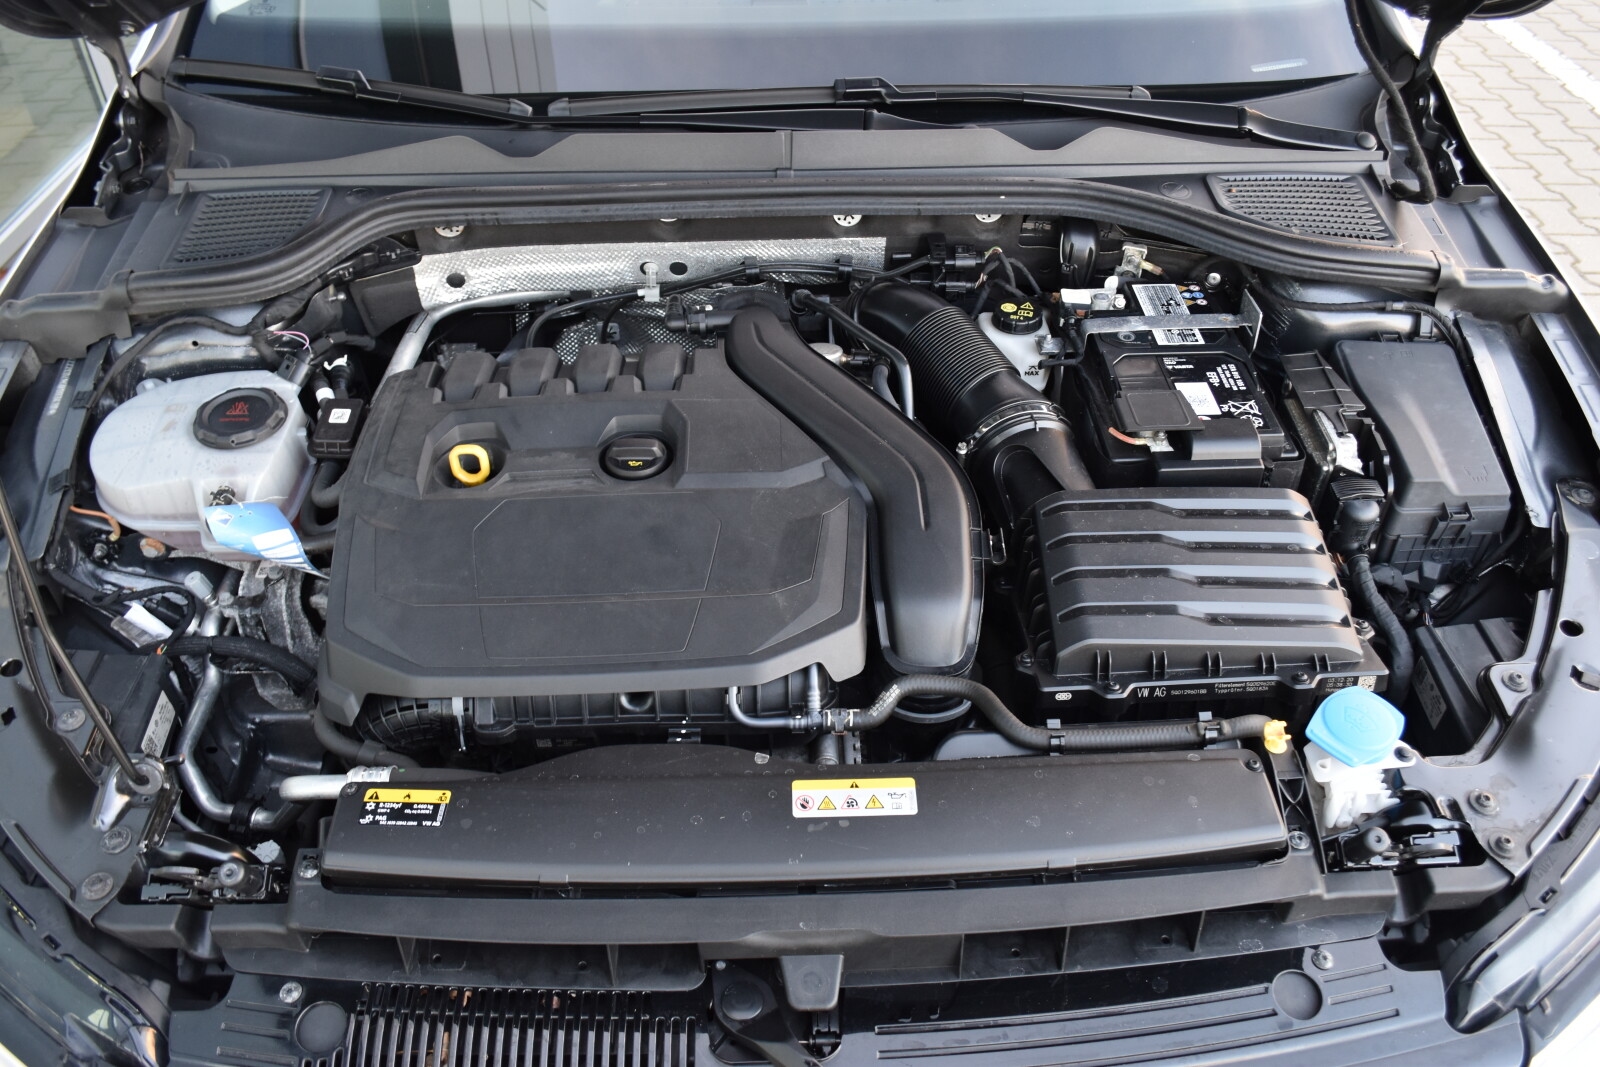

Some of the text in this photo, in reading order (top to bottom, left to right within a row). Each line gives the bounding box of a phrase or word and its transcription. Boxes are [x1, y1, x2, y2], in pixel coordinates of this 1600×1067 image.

[1206, 372, 1220, 387] EFB+
[1220, 404, 1230, 412] Pb
[1137, 688, 1150, 698] VW
[1153, 687, 1166, 698] AG
